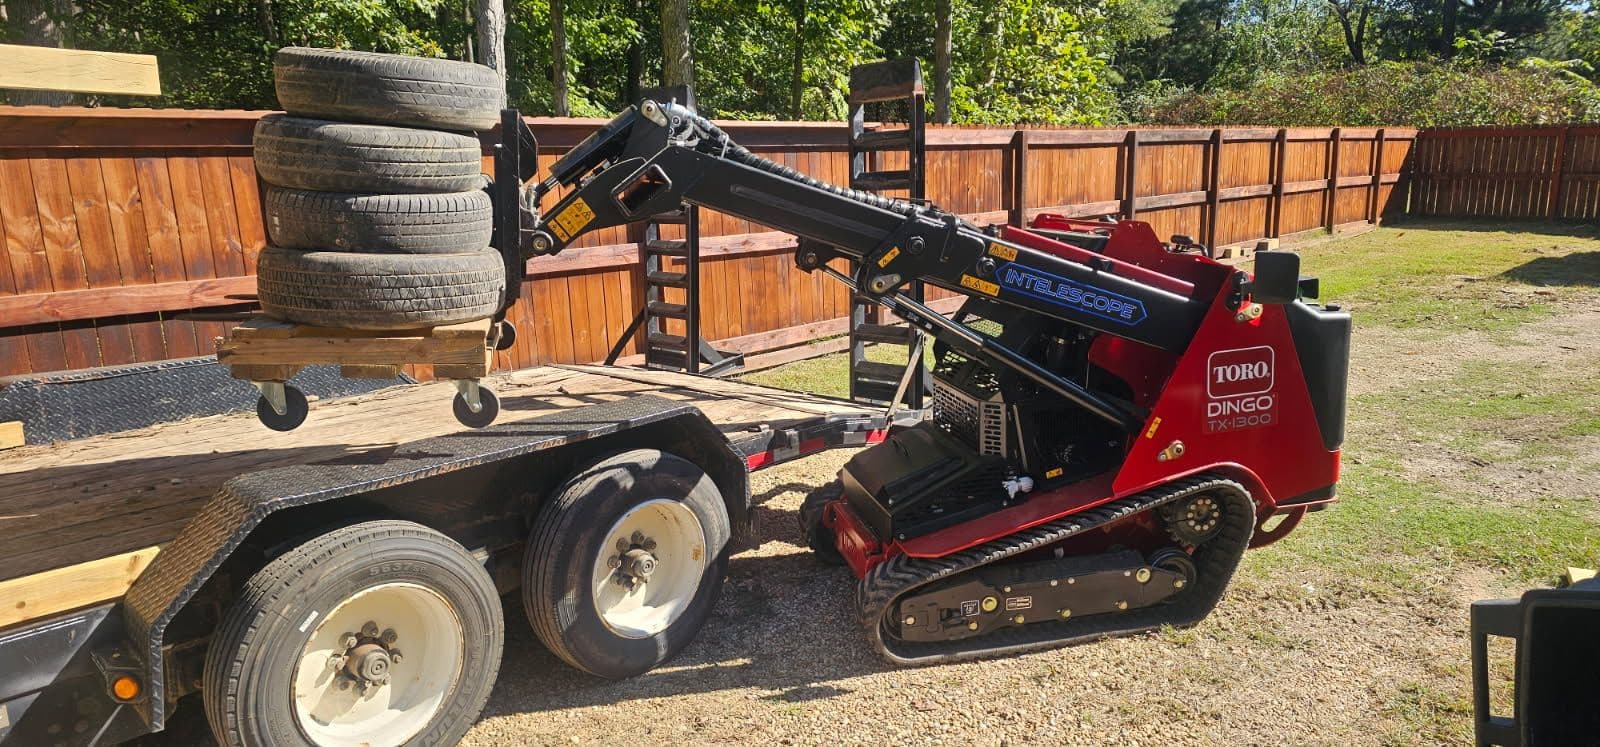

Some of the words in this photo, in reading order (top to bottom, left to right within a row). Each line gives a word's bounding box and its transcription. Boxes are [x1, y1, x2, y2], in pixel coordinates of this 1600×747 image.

[1004, 268, 1138, 319] INTELESCOPE
[1213, 361, 1268, 383] TORO
[1207, 395, 1273, 417] DINGO
